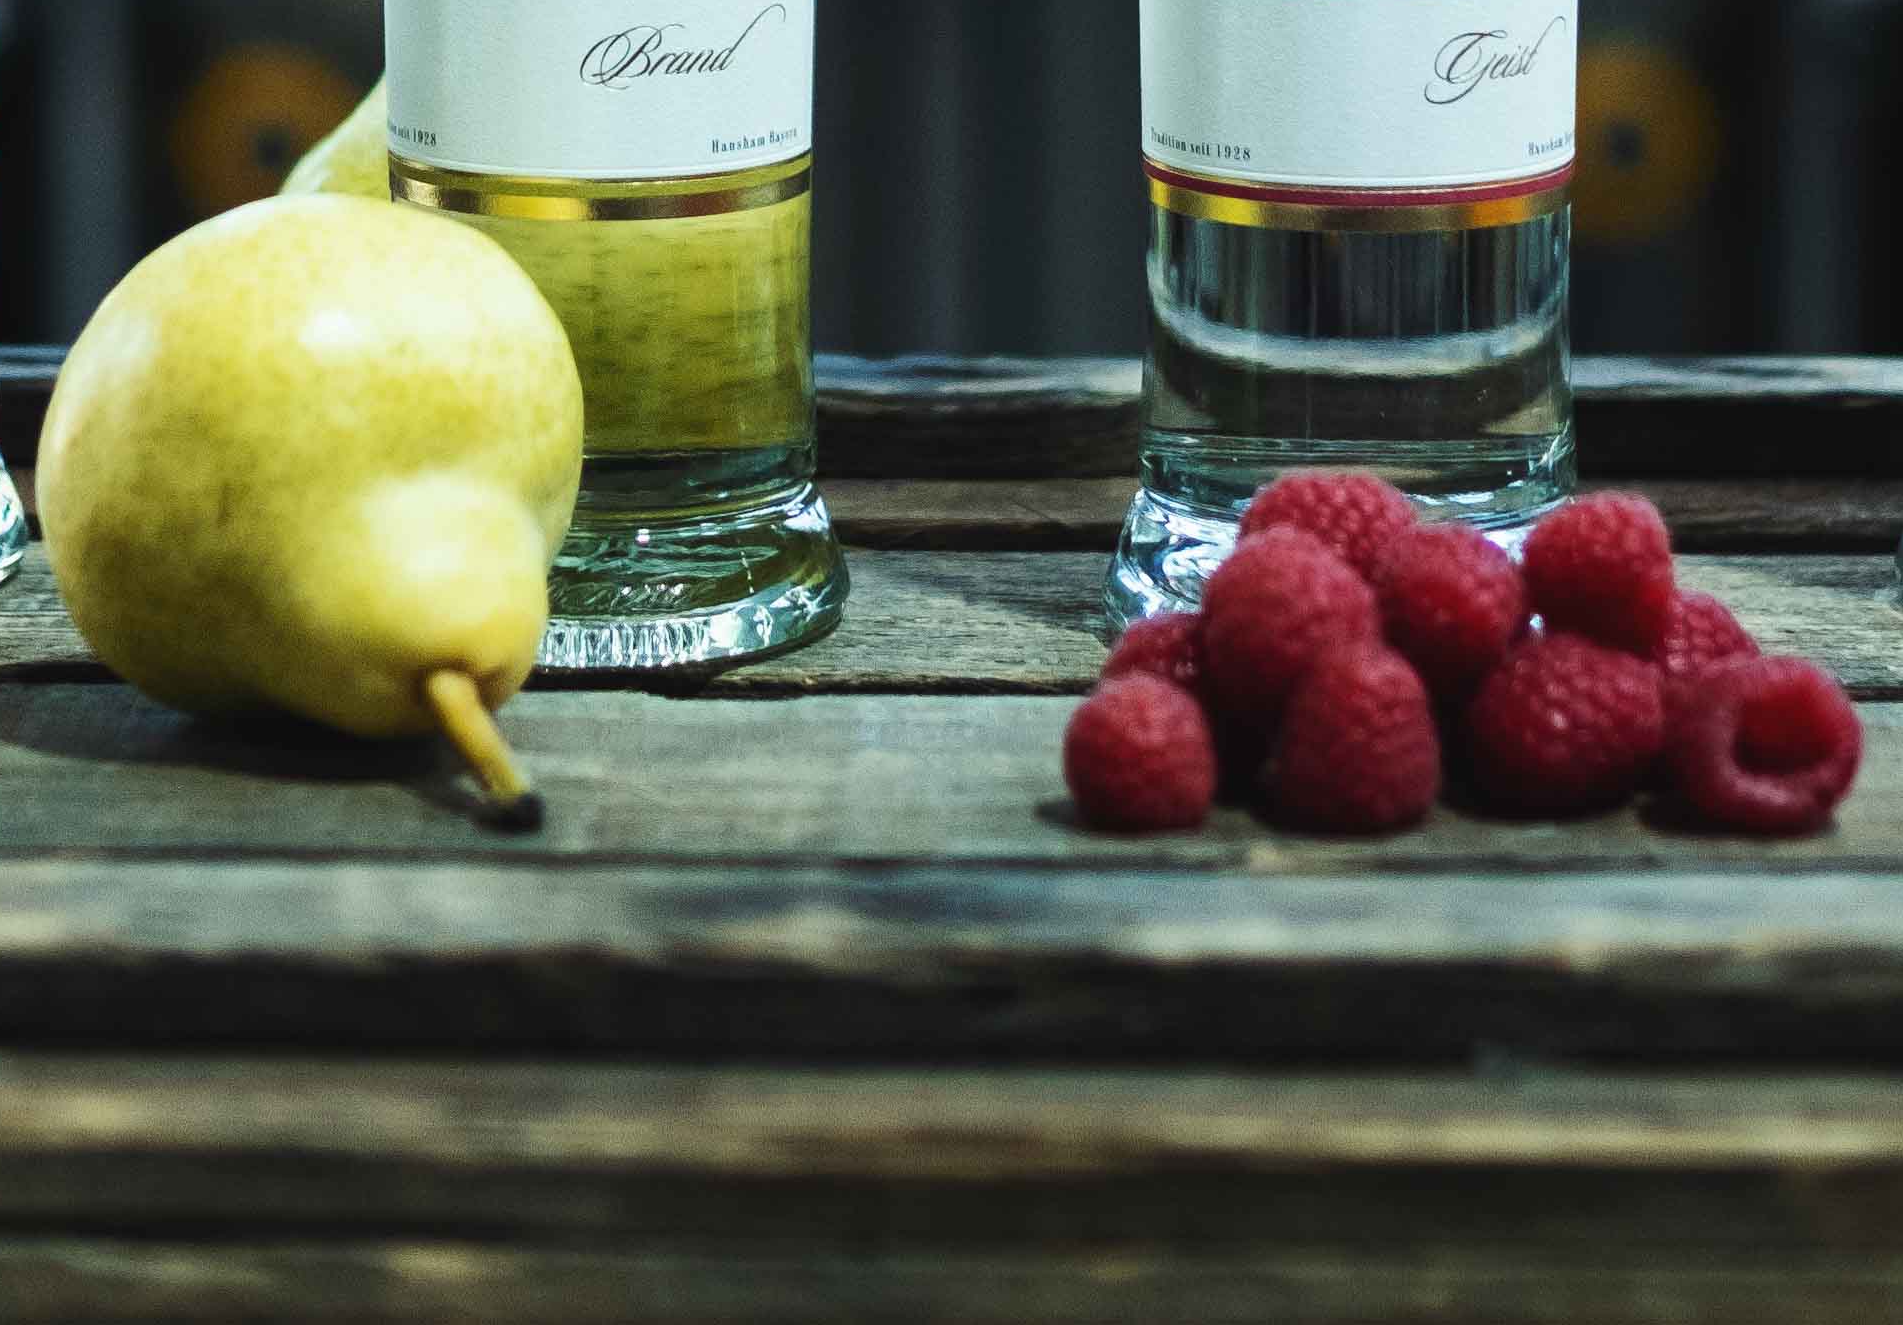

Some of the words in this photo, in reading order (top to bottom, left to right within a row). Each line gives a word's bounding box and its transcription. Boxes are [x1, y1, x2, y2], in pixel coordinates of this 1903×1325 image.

[580, 3, 786, 90] Brand
[1424, 16, 1566, 105] Geist
[413, 127, 436, 147] 1928
[1217, 144, 1251, 161] 1928
